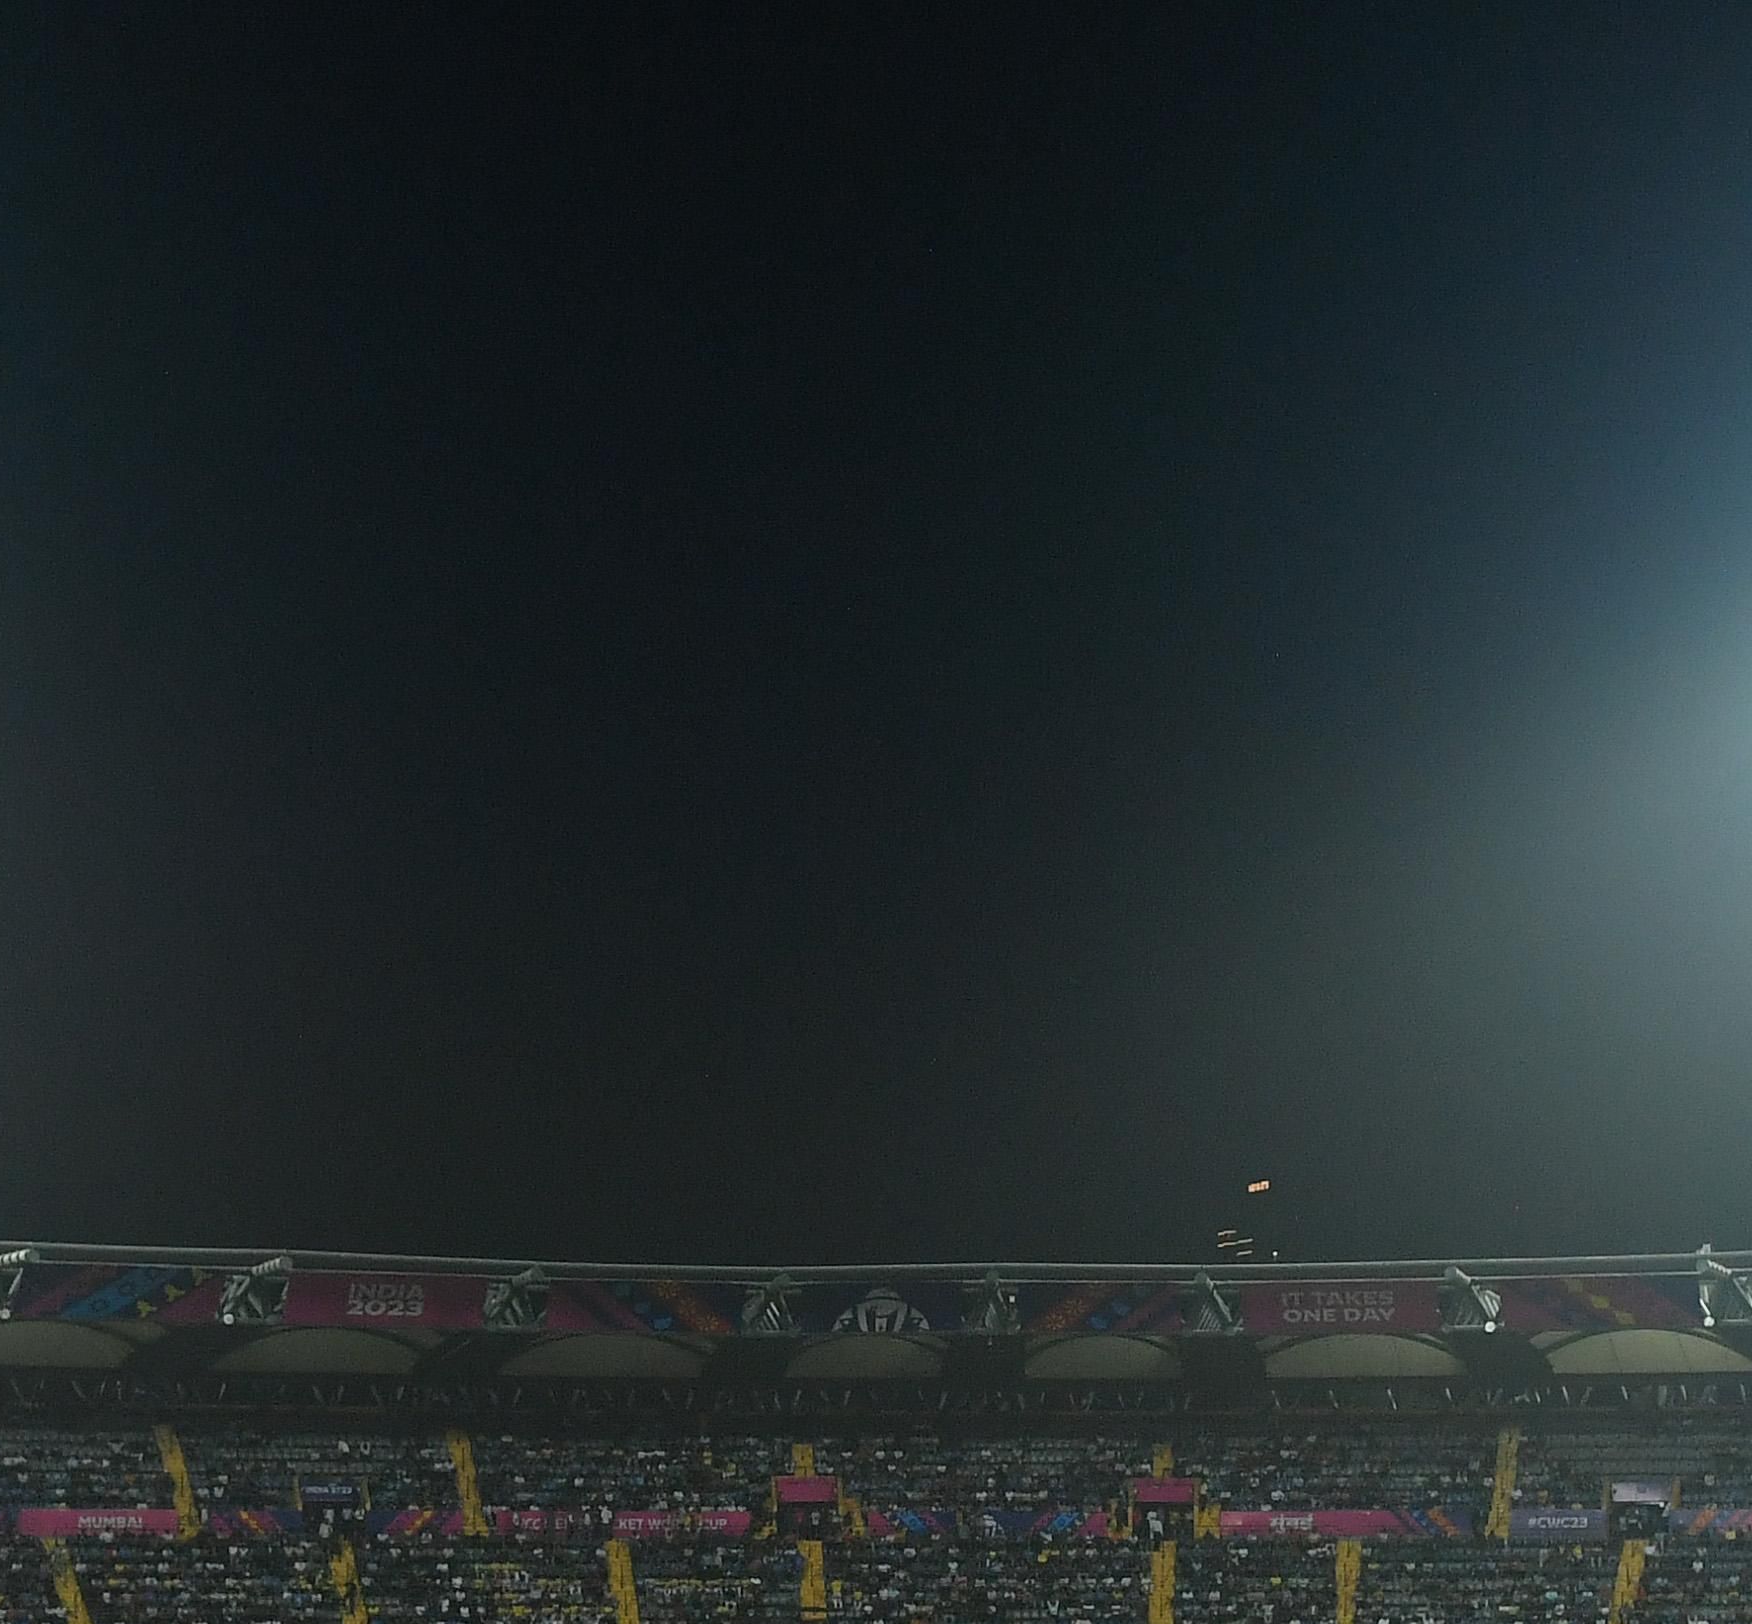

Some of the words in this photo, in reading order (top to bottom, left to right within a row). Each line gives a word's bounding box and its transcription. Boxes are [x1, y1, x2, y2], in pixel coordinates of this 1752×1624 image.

[349, 1282, 424, 1300] INDIA
[1282, 1292, 1304, 1306] IT
[1311, 1291, 1394, 1306] TAKES
[347, 1300, 424, 1316] 2023
[1283, 1308, 1336, 1323] ONE
[1343, 1307, 1396, 1322] DAY
[77, 1514, 144, 1528] MUMBAI
[1527, 1516, 1588, 1530] #CWC23
